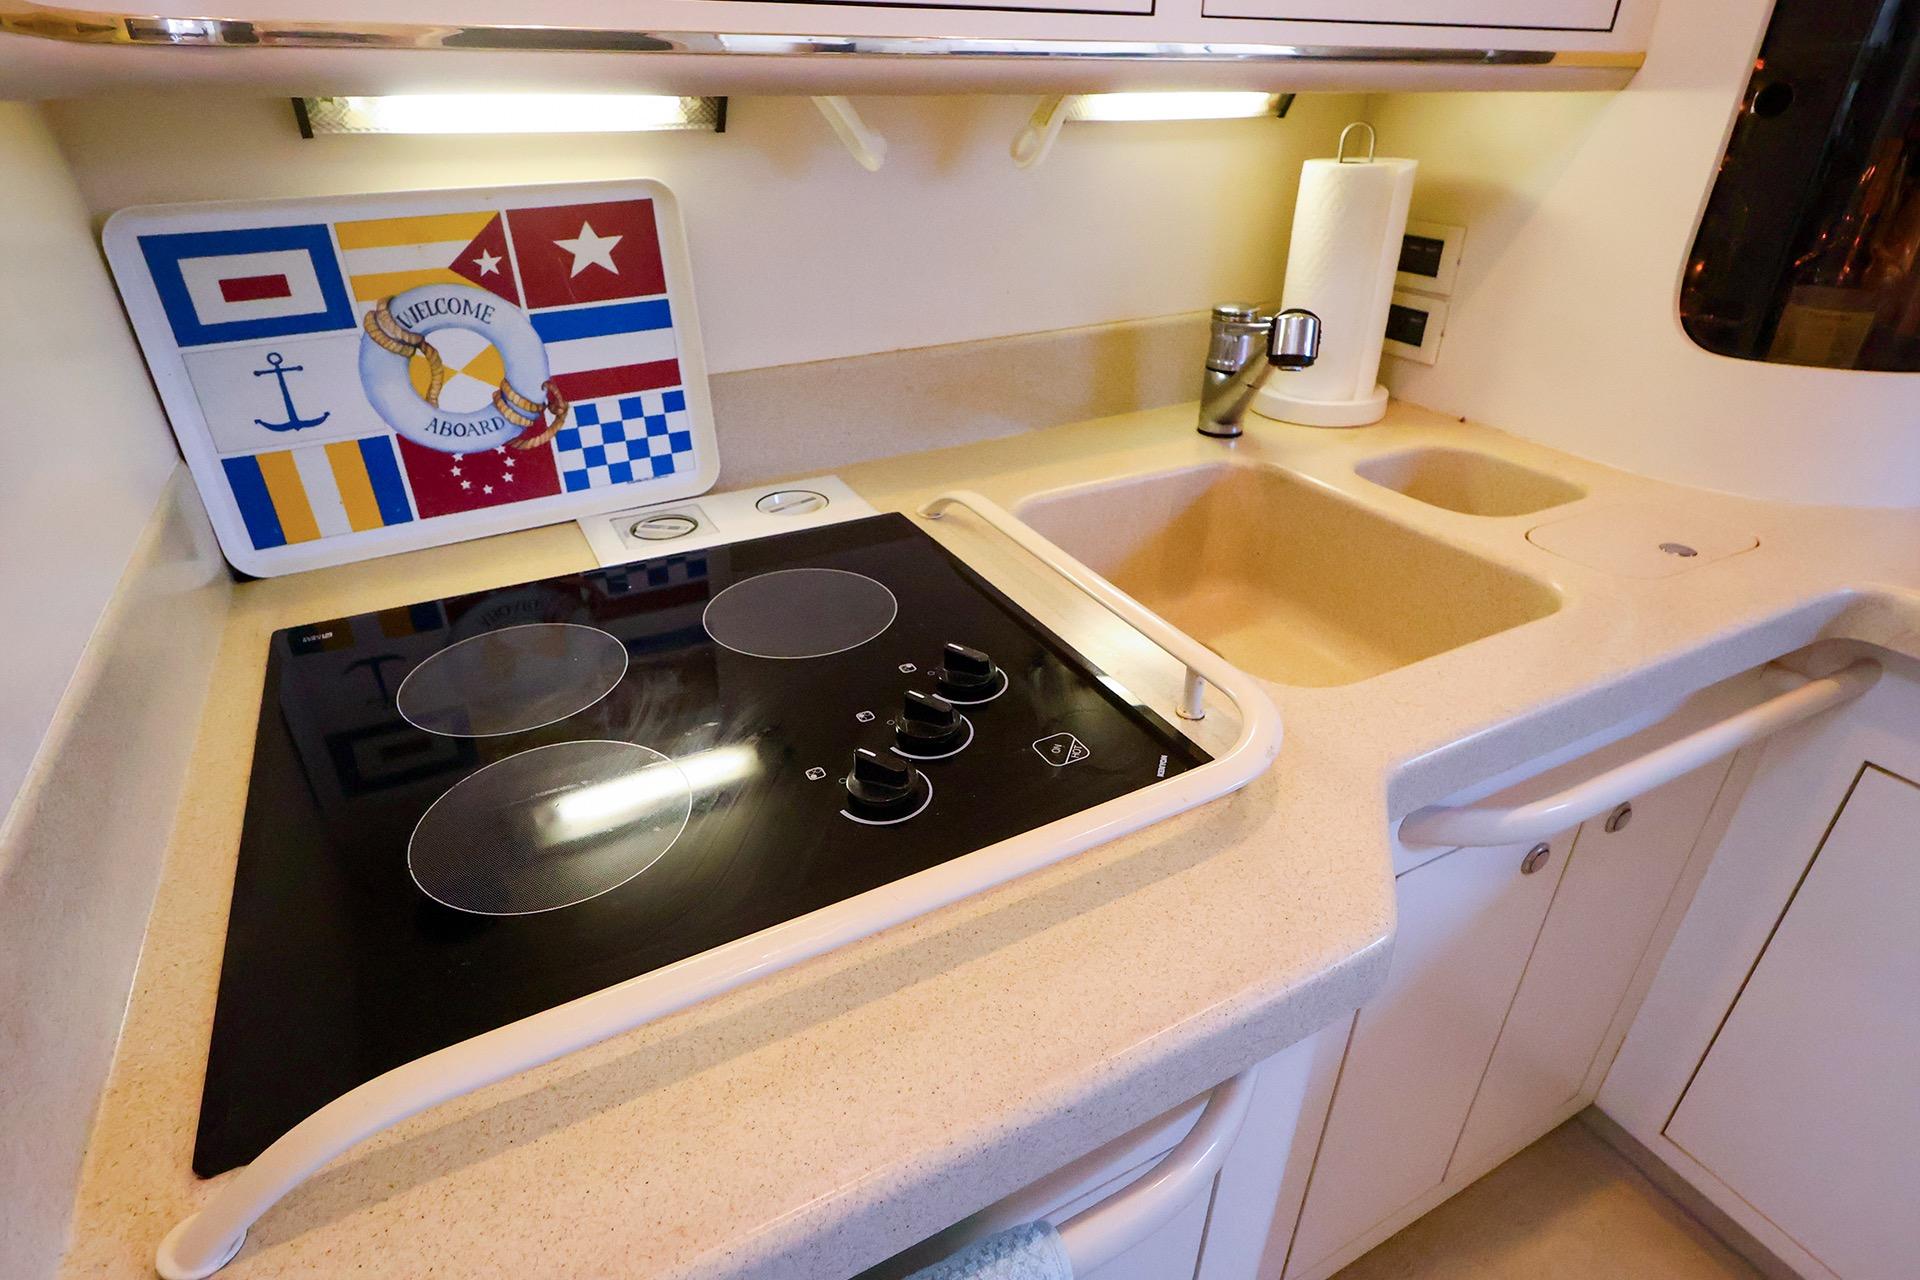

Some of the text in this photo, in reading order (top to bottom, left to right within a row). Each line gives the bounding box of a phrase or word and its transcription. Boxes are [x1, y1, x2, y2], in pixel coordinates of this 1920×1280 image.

[396, 297, 496, 329] WELCOME
[424, 416, 505, 437] ABOARD
[1051, 744, 1062, 754] ON
[1071, 745, 1083, 758] HOT
